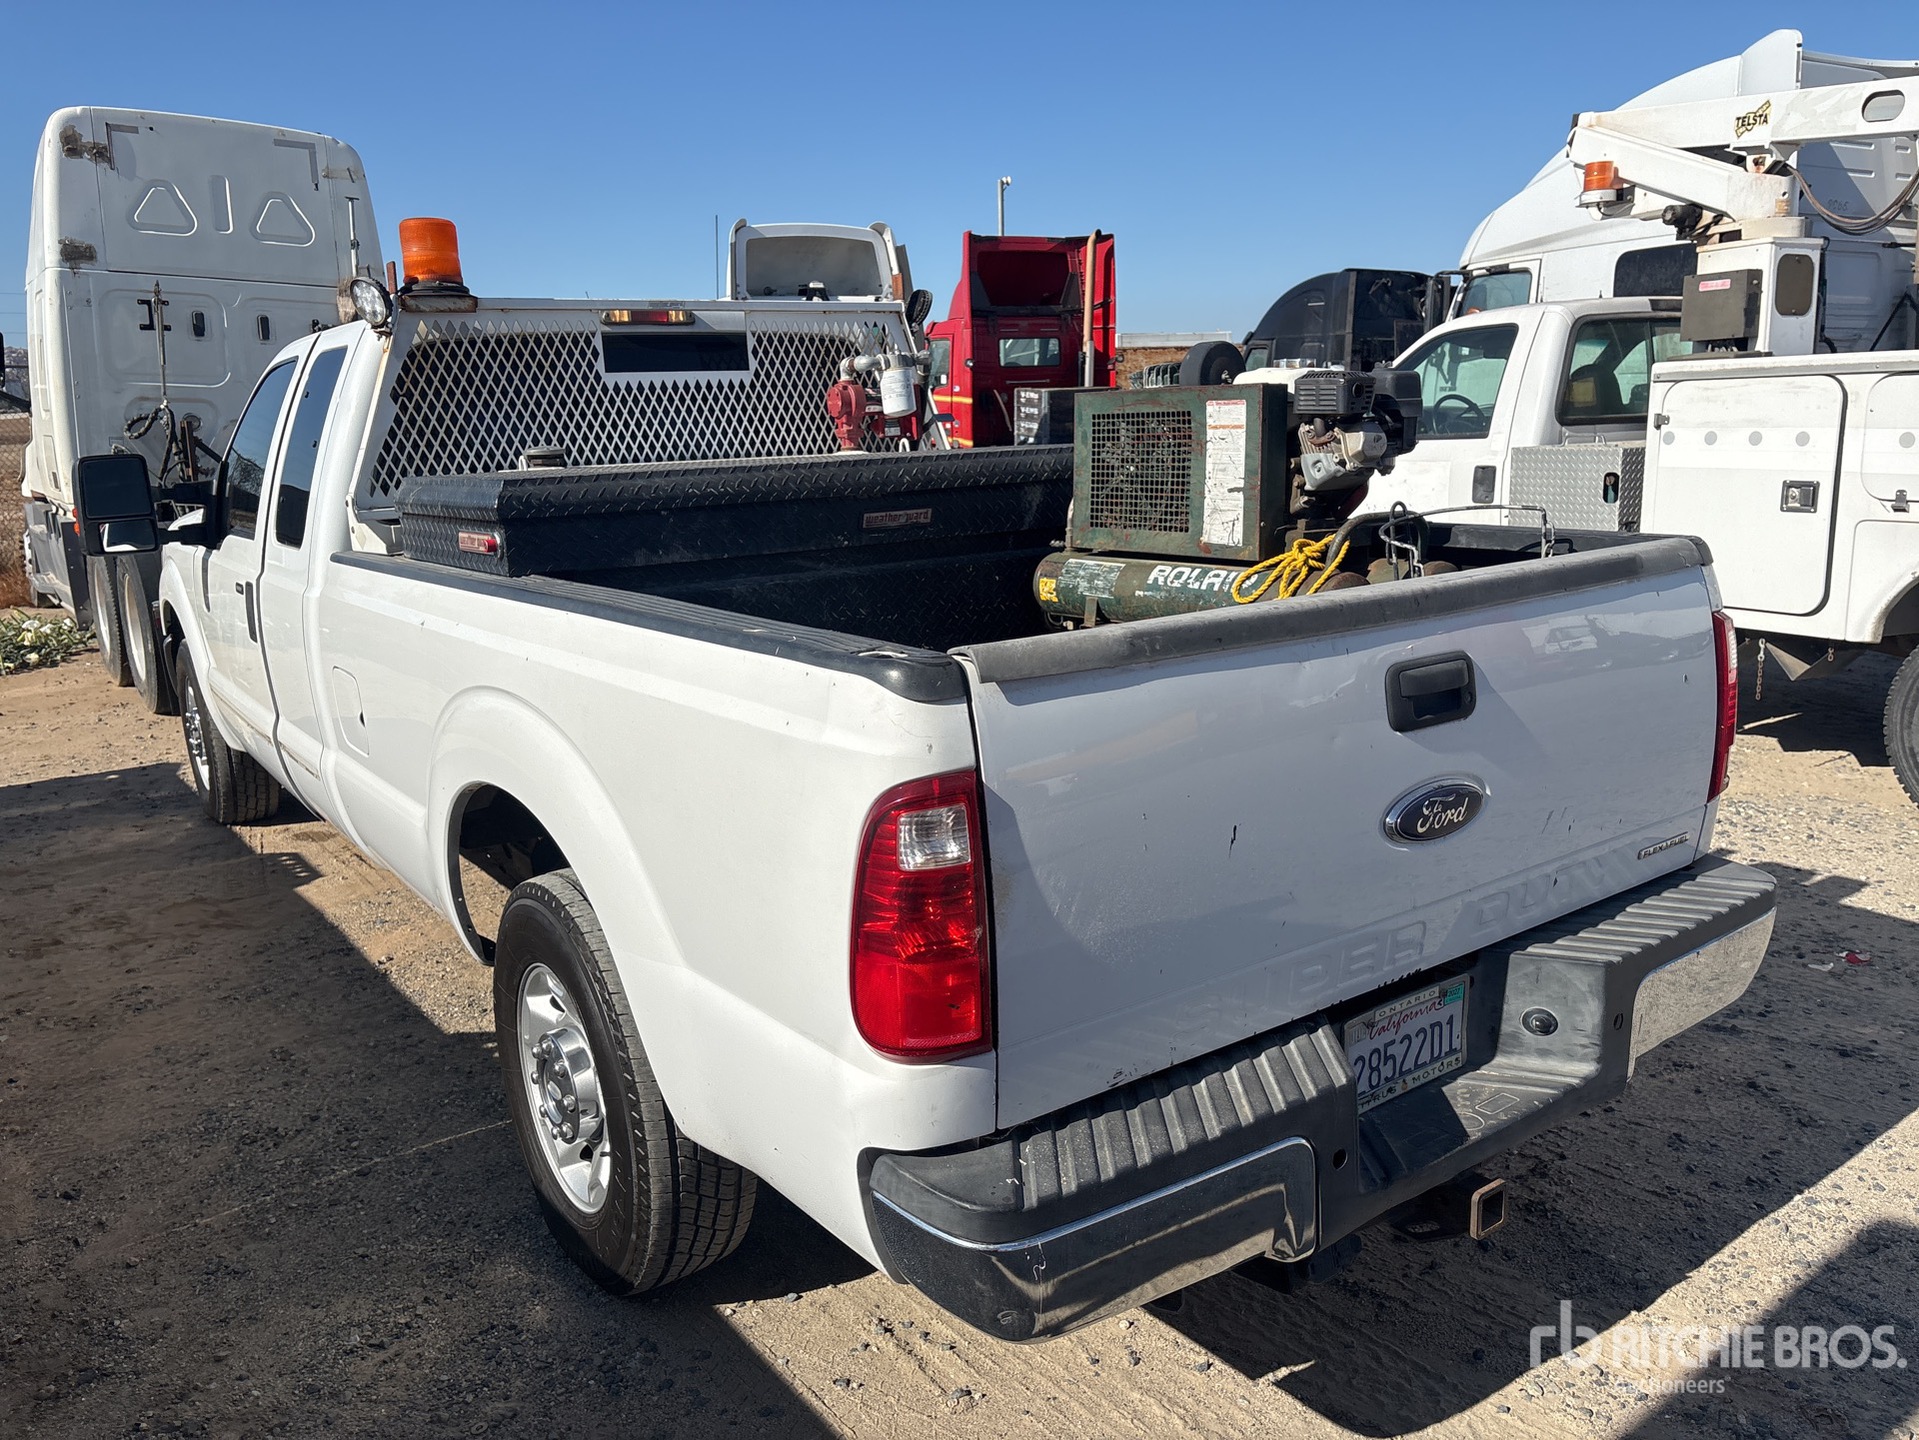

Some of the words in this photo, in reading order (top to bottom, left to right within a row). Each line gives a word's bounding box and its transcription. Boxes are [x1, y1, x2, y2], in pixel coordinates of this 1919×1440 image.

[1735, 113, 1768, 128] TELSTA
[1416, 792, 1469, 834] Ford
[1642, 844, 1664, 859] FLEX
[1669, 834, 1690, 848] FUEL
[1378, 989, 1437, 1017] ONTARIO
[1368, 999, 1445, 1041] California
[1353, 1013, 1458, 1097] 28522D1
[1411, 1057, 1462, 1084] MOTORS
